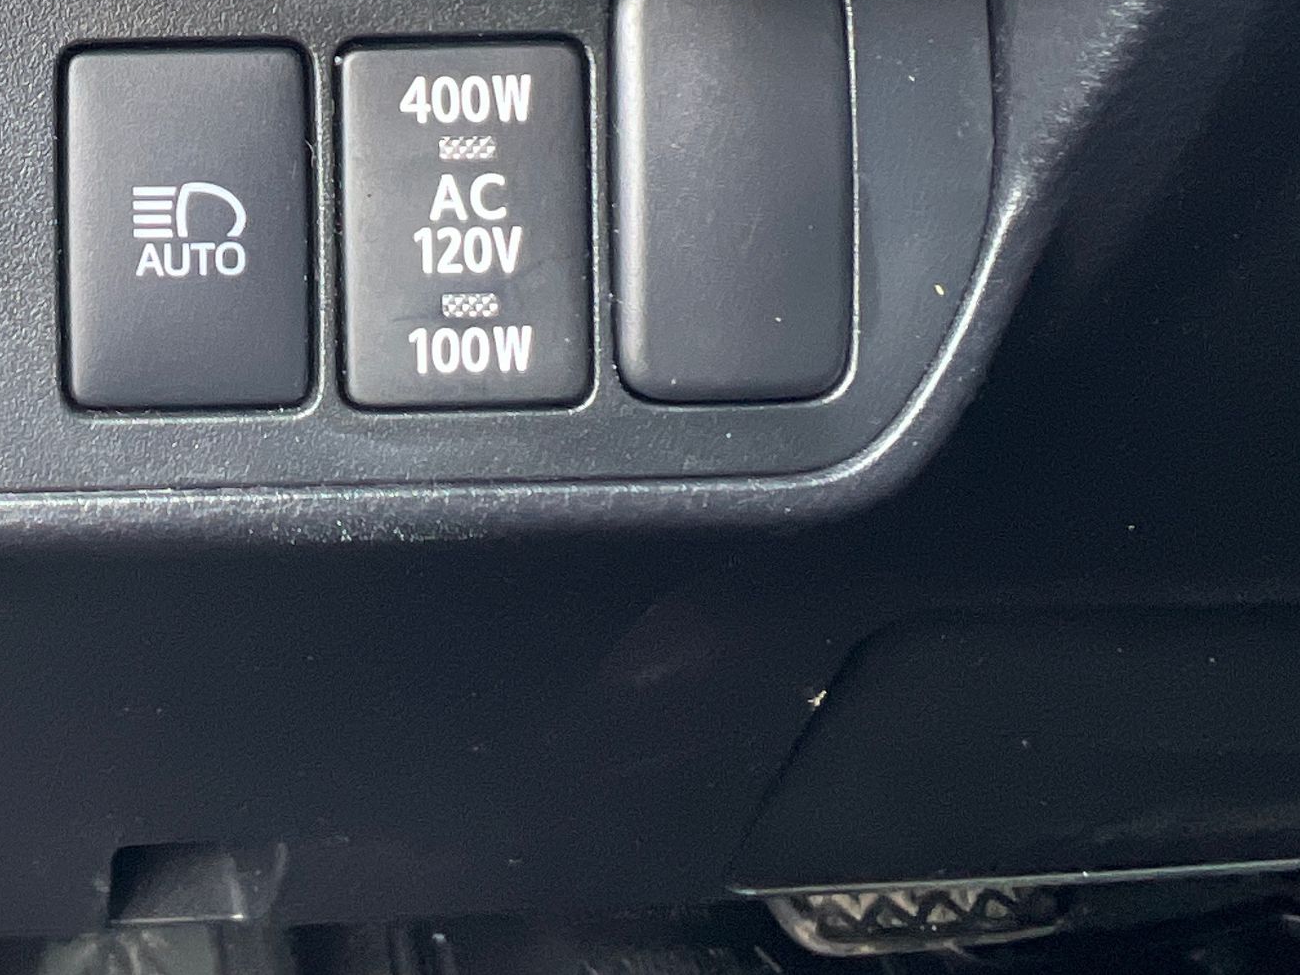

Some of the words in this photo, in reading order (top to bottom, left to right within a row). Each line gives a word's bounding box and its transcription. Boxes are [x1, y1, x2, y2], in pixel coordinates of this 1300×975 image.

[399, 74, 532, 124] 400W
[429, 172, 507, 222] AC
[135, 241, 246, 277] AUTO
[413, 226, 523, 275] 120V
[408, 325, 533, 375] 100W
